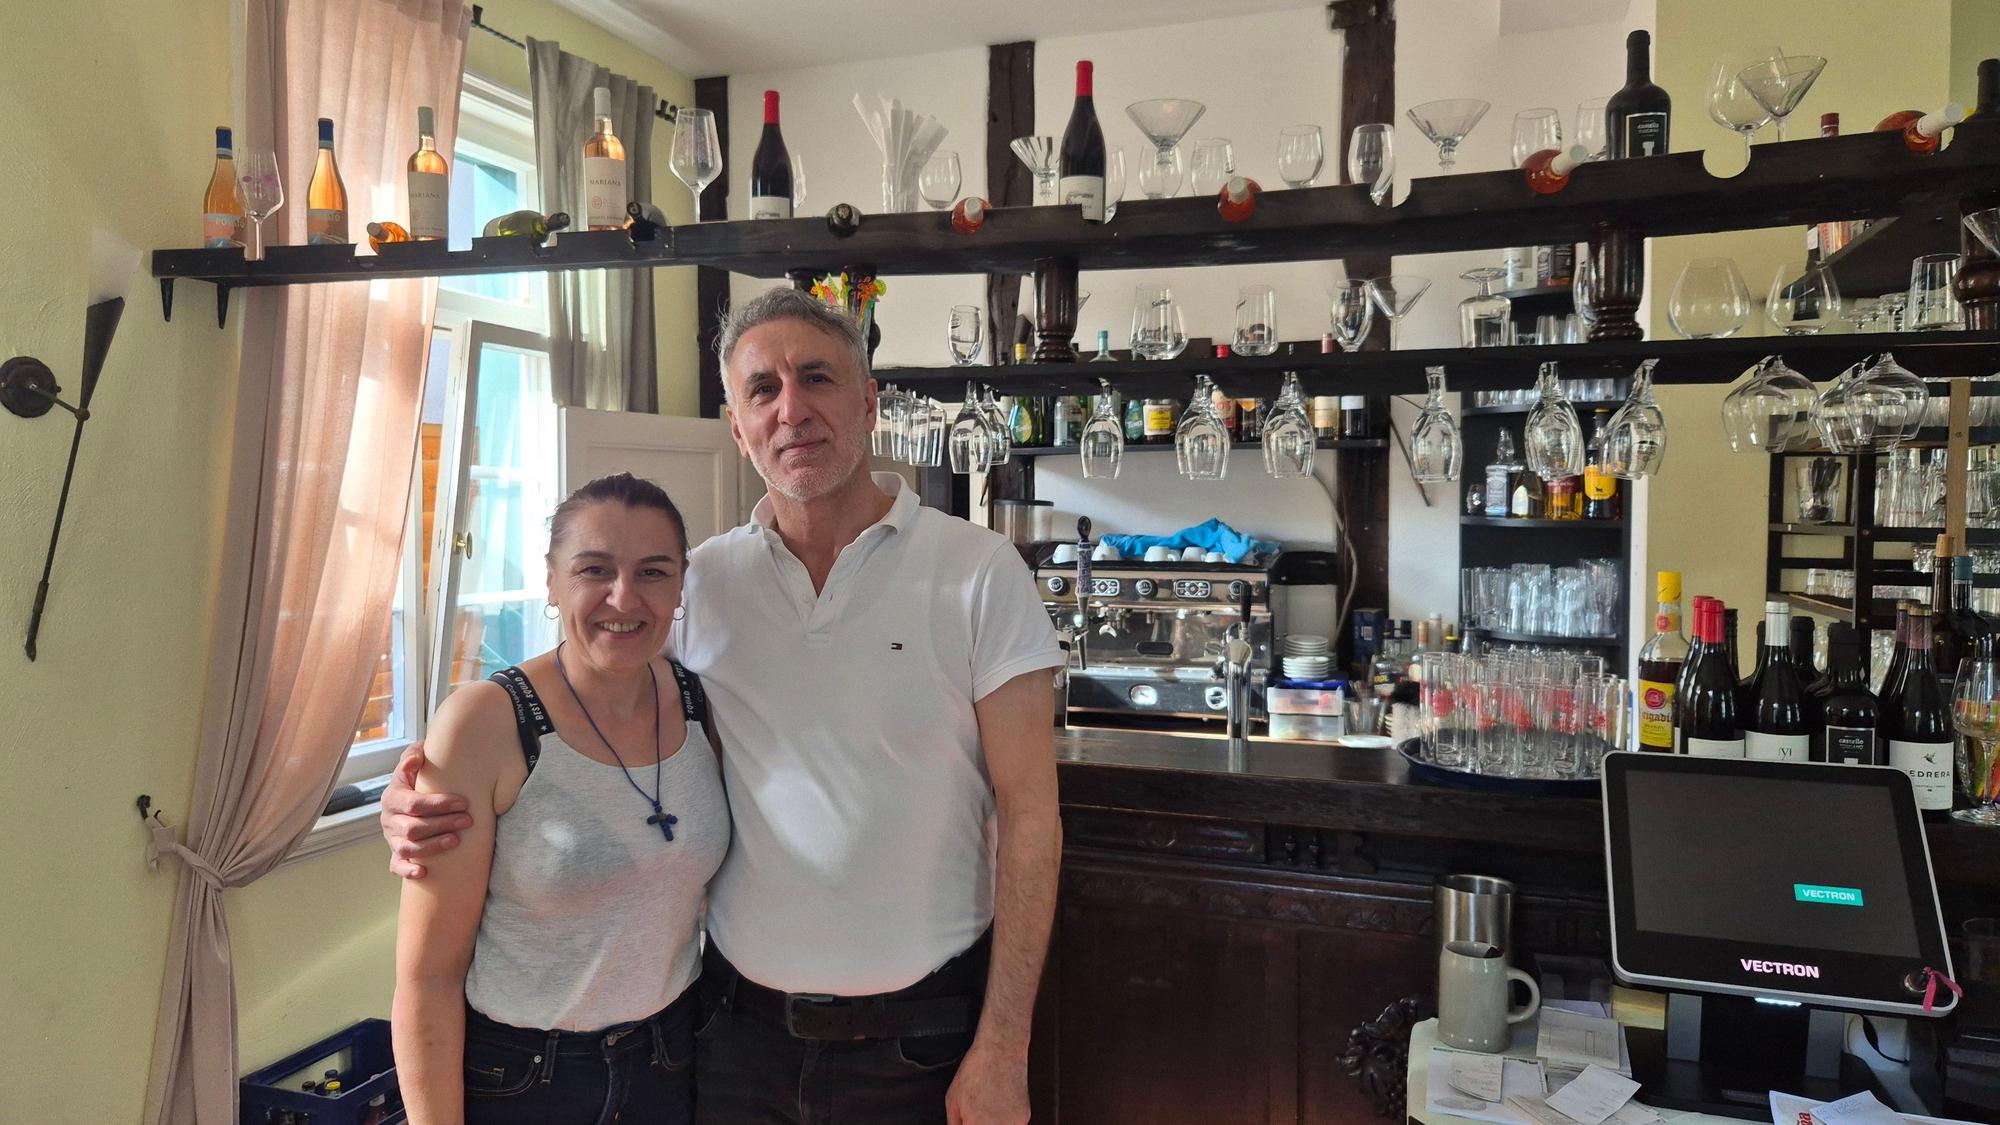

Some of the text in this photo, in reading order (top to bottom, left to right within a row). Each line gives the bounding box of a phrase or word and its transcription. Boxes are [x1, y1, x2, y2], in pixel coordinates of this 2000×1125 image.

[589, 179, 621, 187] MARIANA
[515, 676, 544, 720] BEST SQUAD
[1905, 769, 1951, 778] EDRERA
[1802, 889, 1856, 901] VECTRON
[1740, 958, 1820, 979] VECTRON
